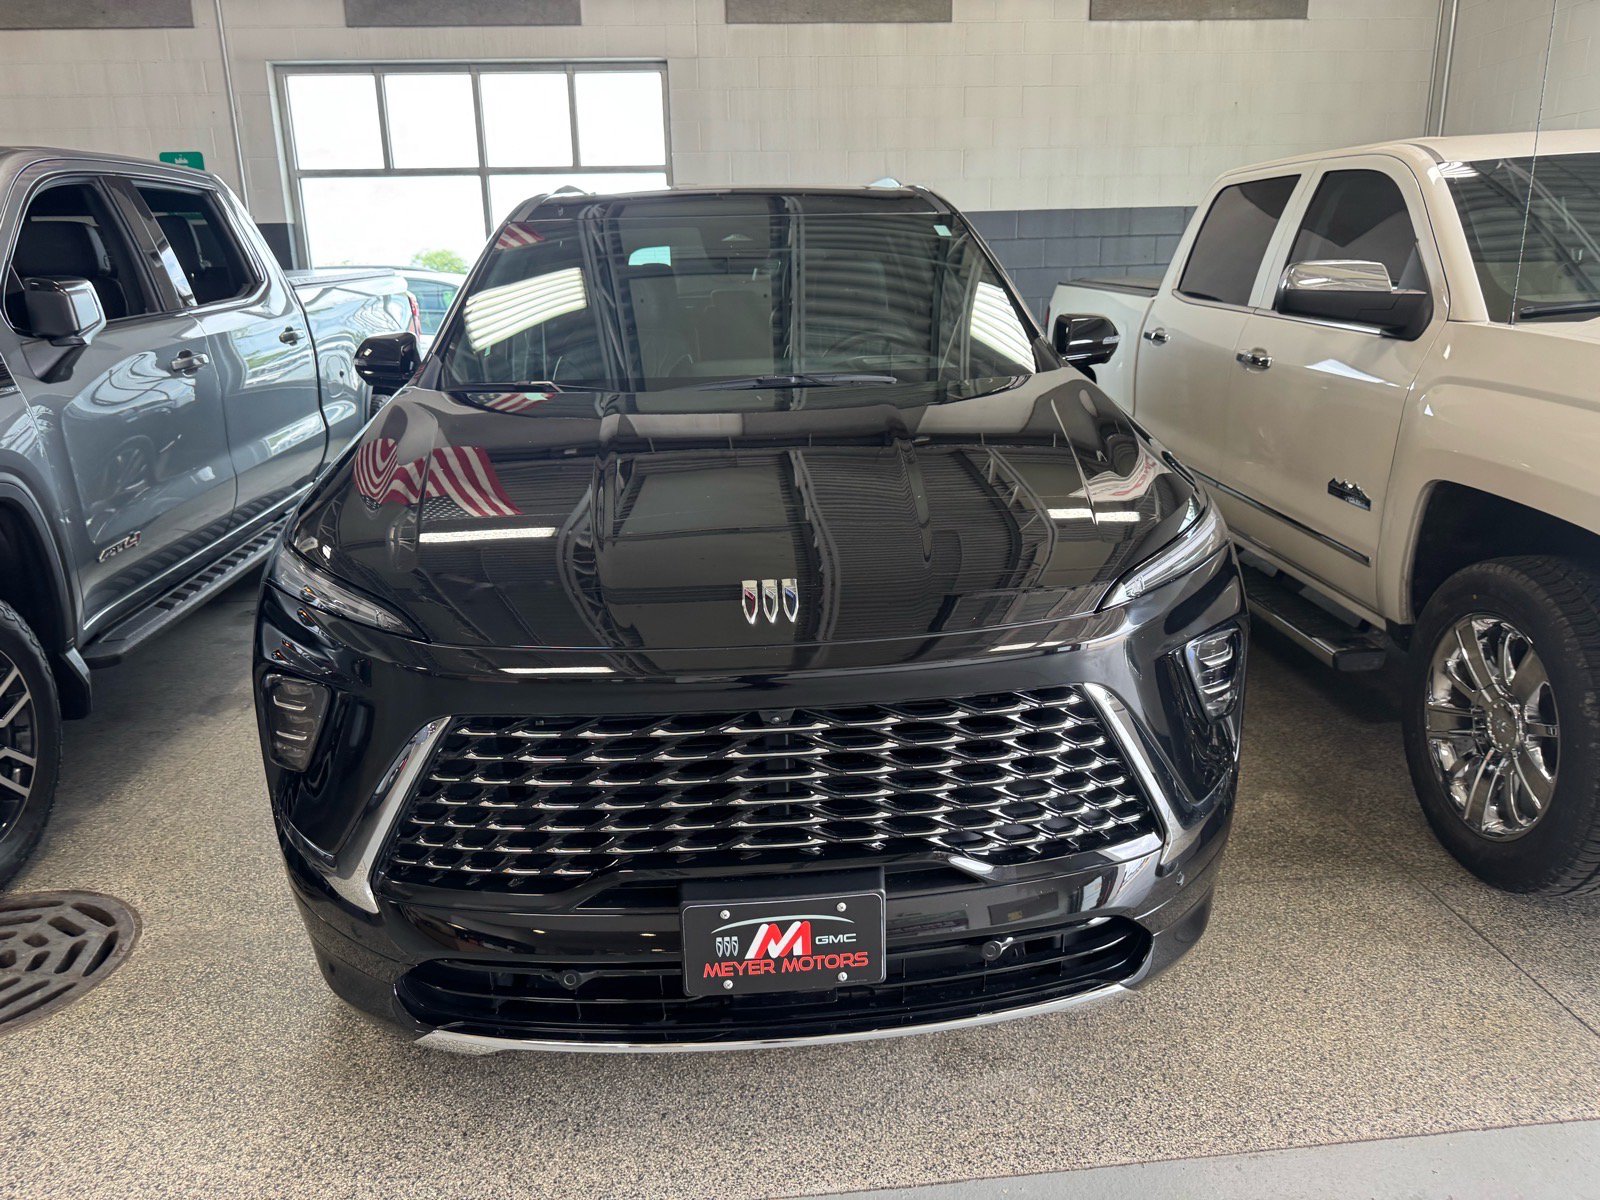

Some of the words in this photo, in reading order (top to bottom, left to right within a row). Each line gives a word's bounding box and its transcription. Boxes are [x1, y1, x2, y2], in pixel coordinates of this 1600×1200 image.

[815, 933, 857, 945] GMC
[703, 959, 776, 979] MEYER
[781, 951, 869, 974] MOTORS
